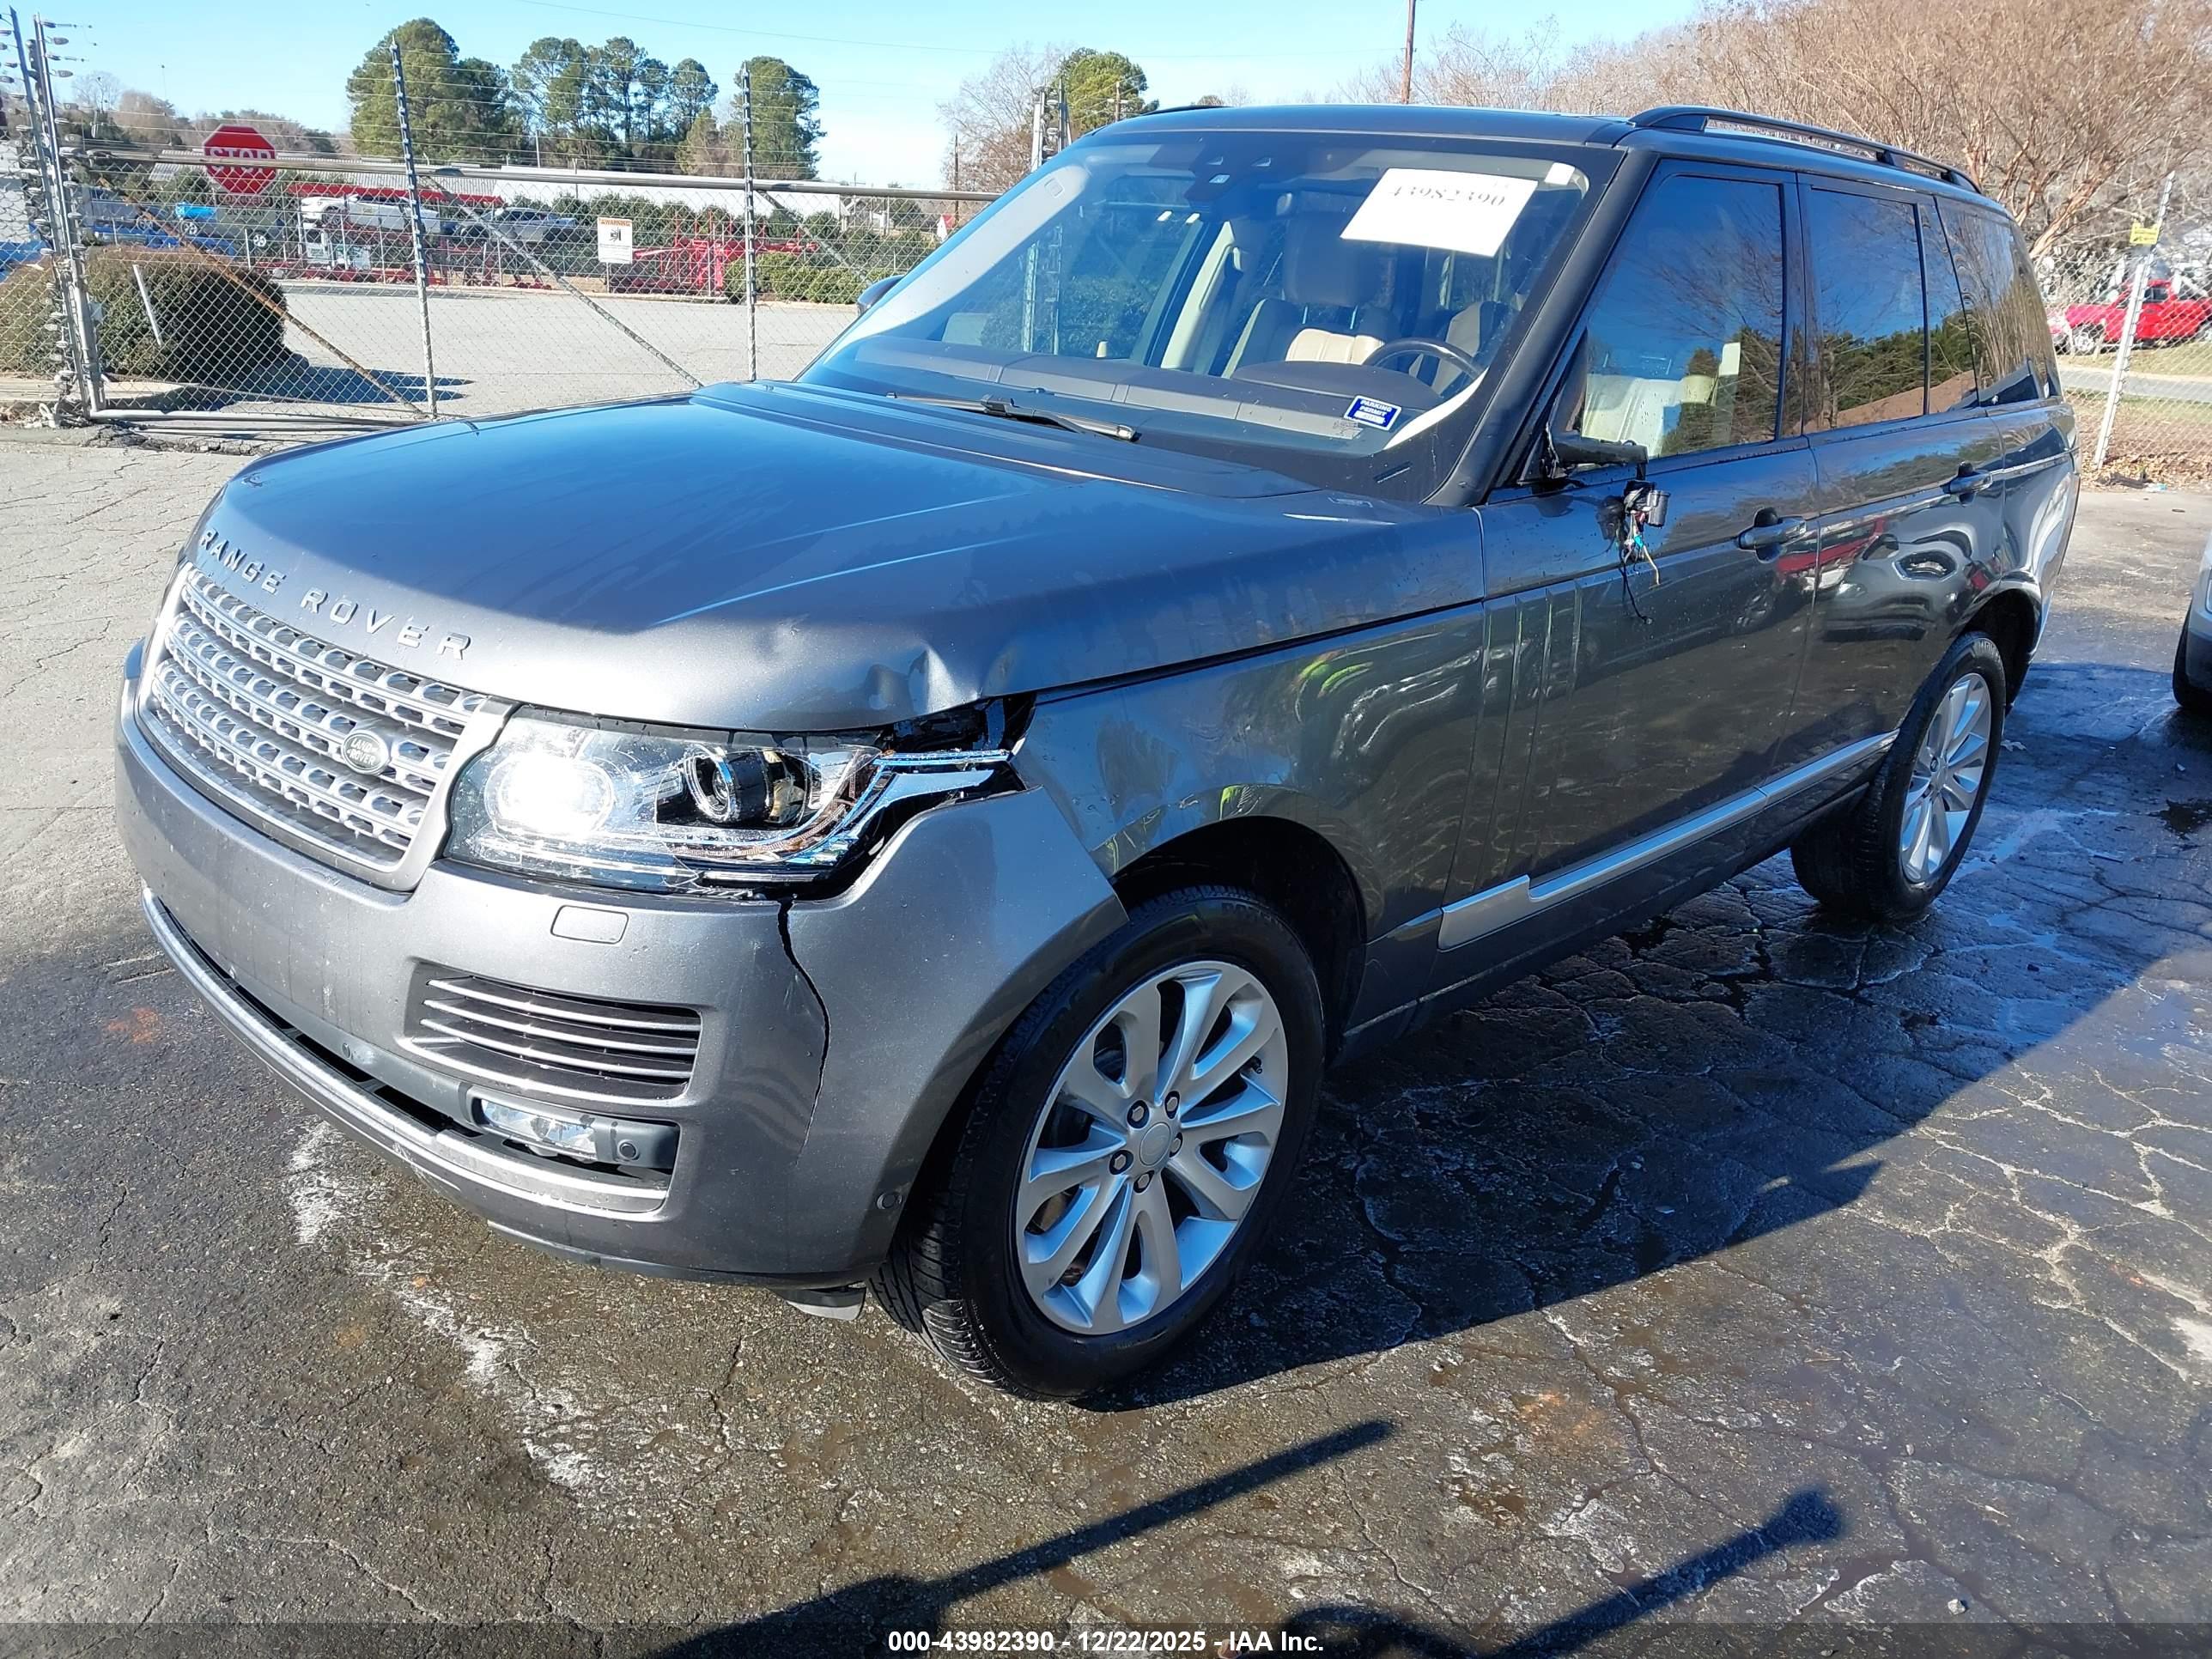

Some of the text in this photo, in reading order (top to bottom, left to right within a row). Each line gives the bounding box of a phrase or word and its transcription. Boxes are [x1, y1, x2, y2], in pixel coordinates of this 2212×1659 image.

[210, 147, 271, 173] STOP
[1358, 405, 1388, 416] PERMIT
[1359, 399, 1393, 412] PARKING
[199, 527, 472, 660] RANGE ROVER
[350, 738, 373, 752] LAND
[349, 749, 376, 765] ROVER
